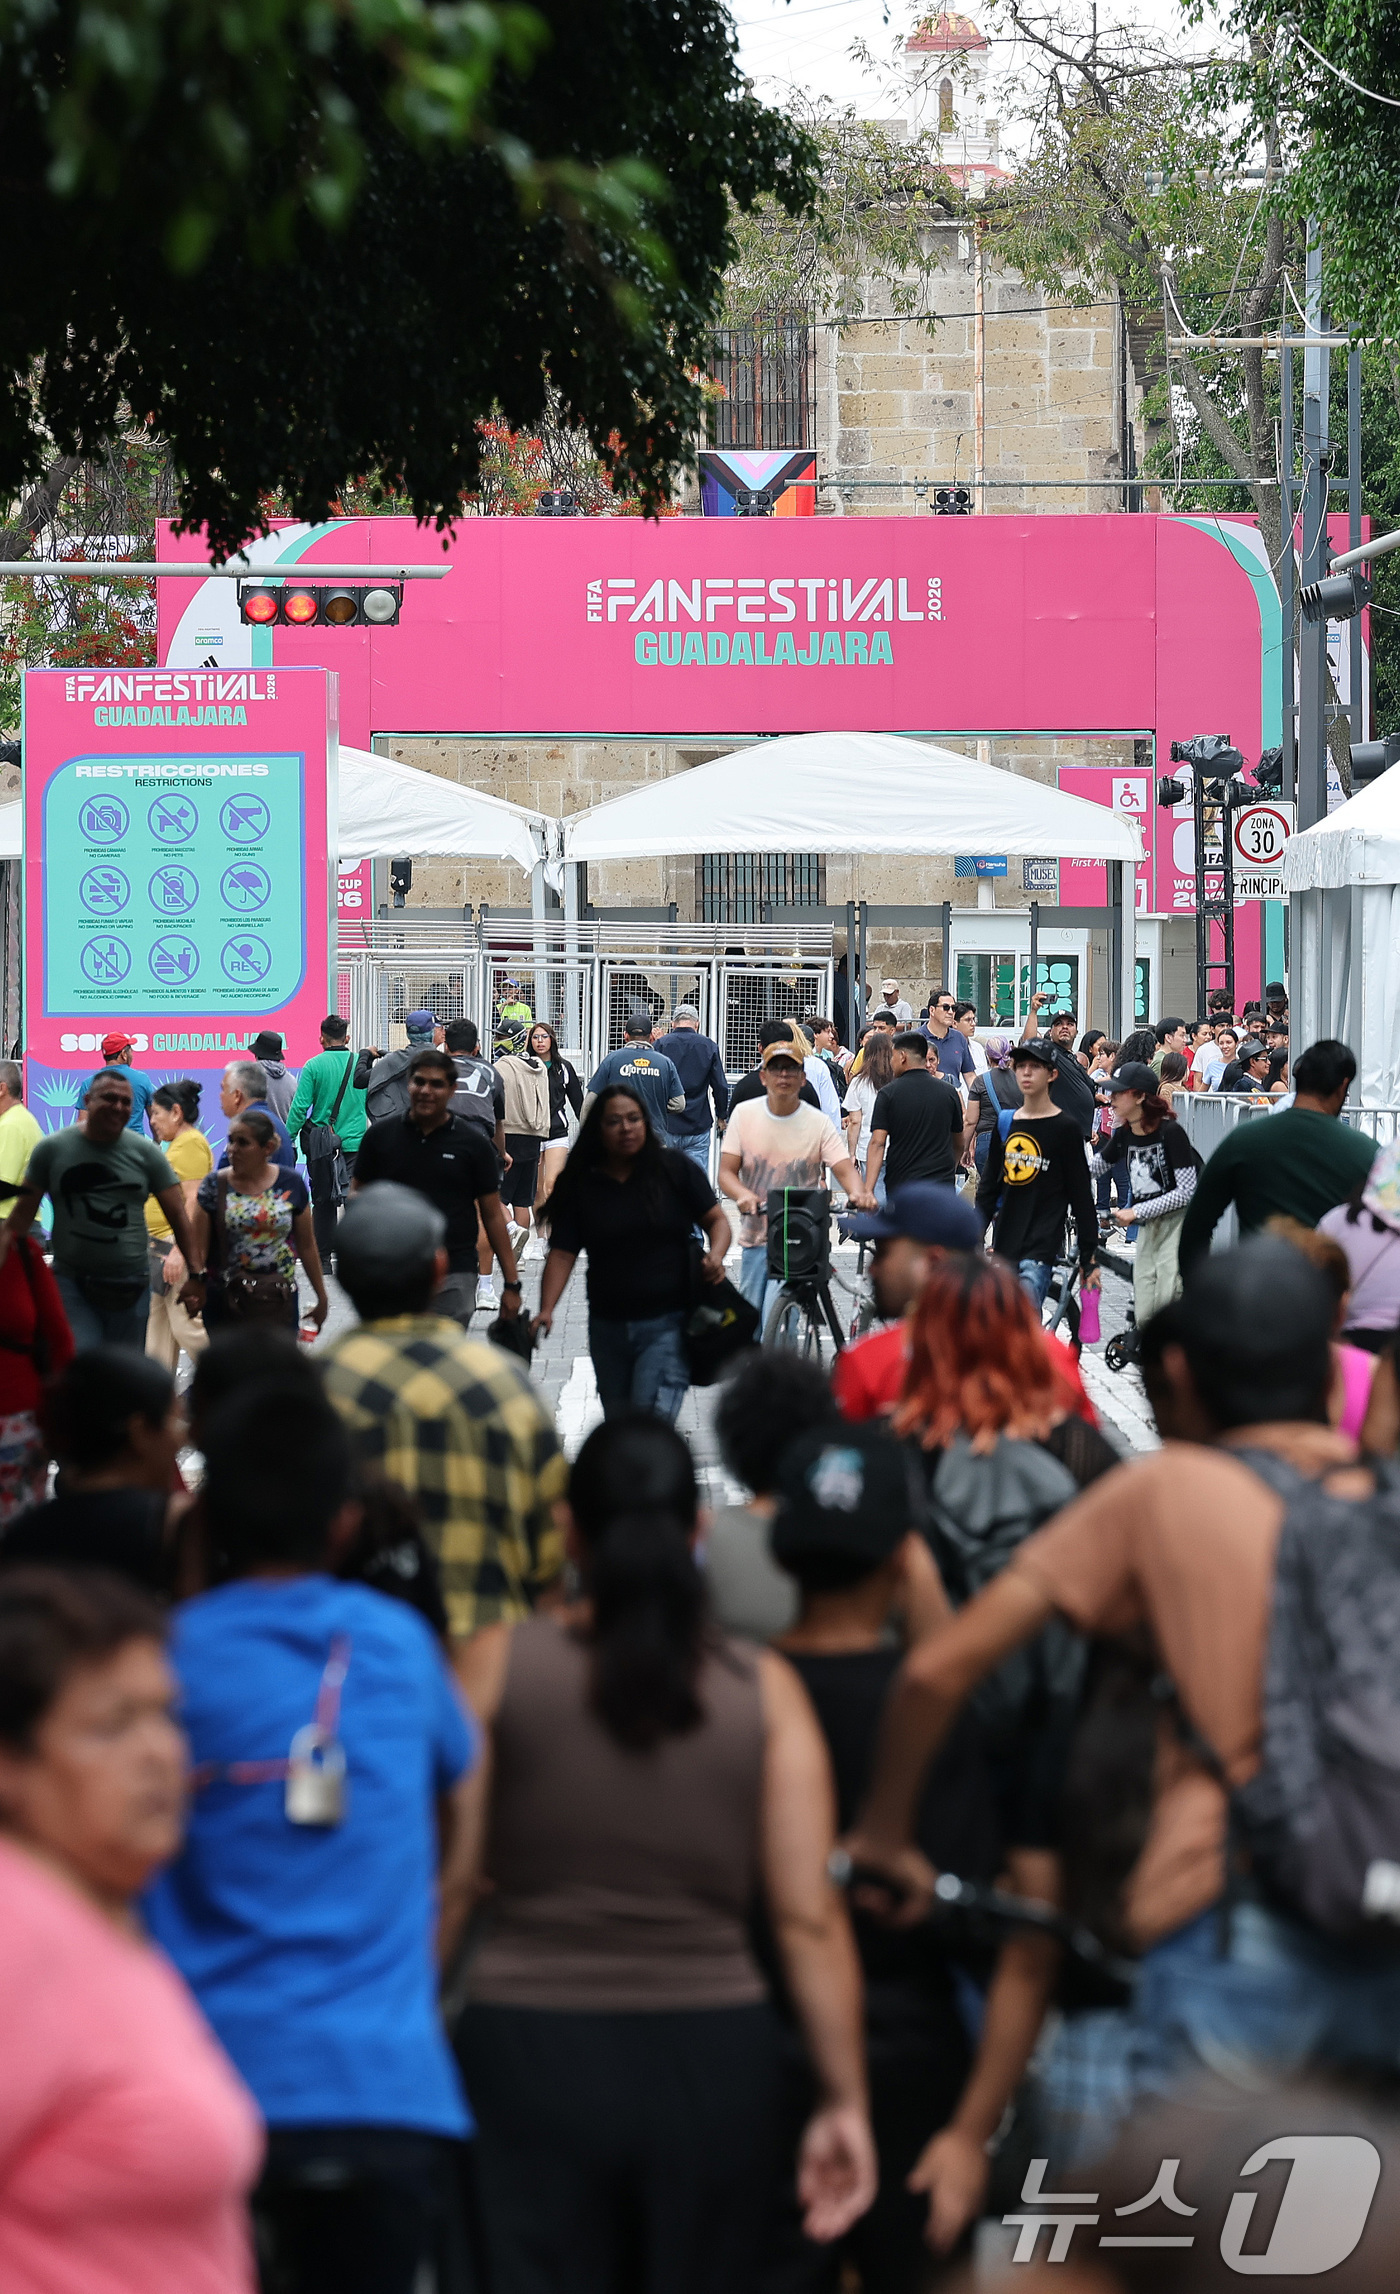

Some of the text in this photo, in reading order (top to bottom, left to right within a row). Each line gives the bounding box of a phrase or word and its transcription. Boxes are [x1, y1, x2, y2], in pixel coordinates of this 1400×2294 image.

[587, 579, 602, 622] FIFA
[928, 577, 942, 621] 2026
[634, 631, 894, 666] GUADALAJARA
[65, 676, 76, 702] FIFA
[267, 674, 276, 700] 2026
[94, 706, 248, 727] GUADALAJARA
[75, 764, 269, 778] RESTRICCIONES
[135, 778, 213, 787] RESTRICTIONS
[1250, 818, 1275, 829] ZONA
[1251, 831, 1274, 854] 30
[1071, 858, 1091, 867] First
[338, 879, 362, 889] CUP
[1173, 879, 1219, 889] WOLD
[60, 1032, 287, 1051] SOS GUADALAJ
[620, 1063, 660, 1077] Corona
